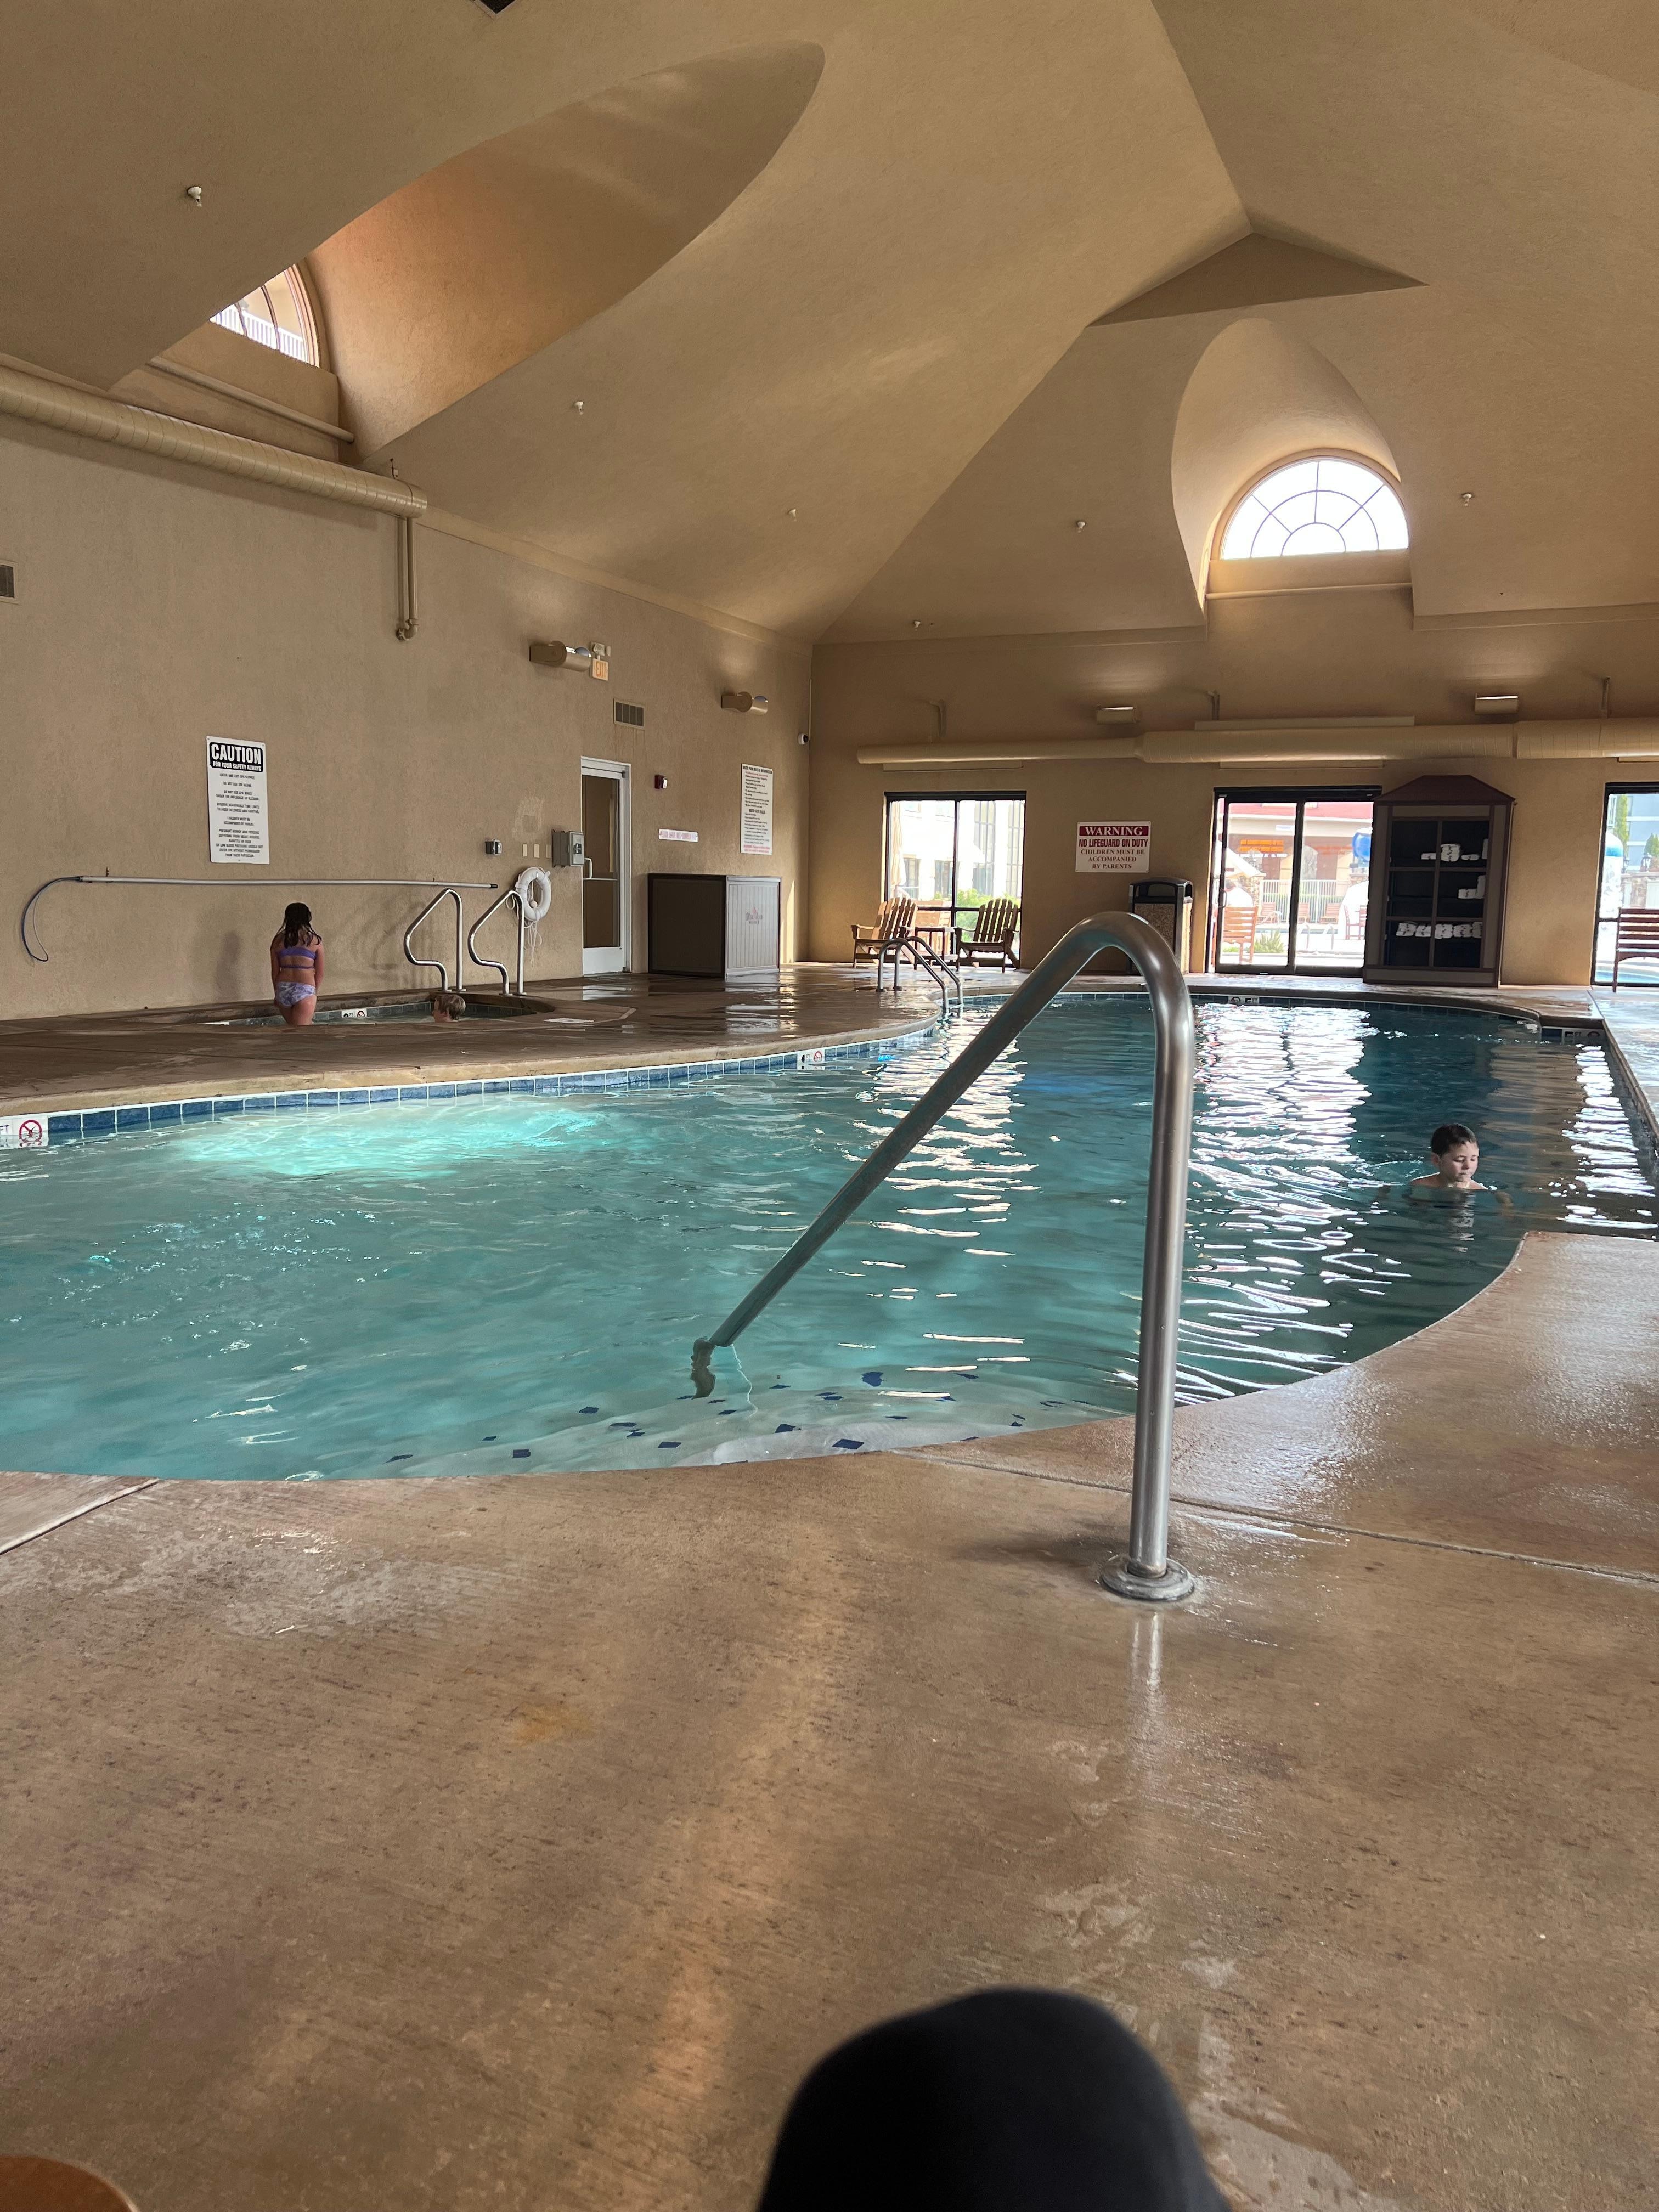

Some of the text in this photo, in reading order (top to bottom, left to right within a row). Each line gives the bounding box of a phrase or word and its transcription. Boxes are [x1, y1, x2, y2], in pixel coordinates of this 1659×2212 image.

[596, 661, 607, 678] EXIT
[211, 743, 261, 764] CAUTION
[1085, 827, 1143, 835] WARNING
